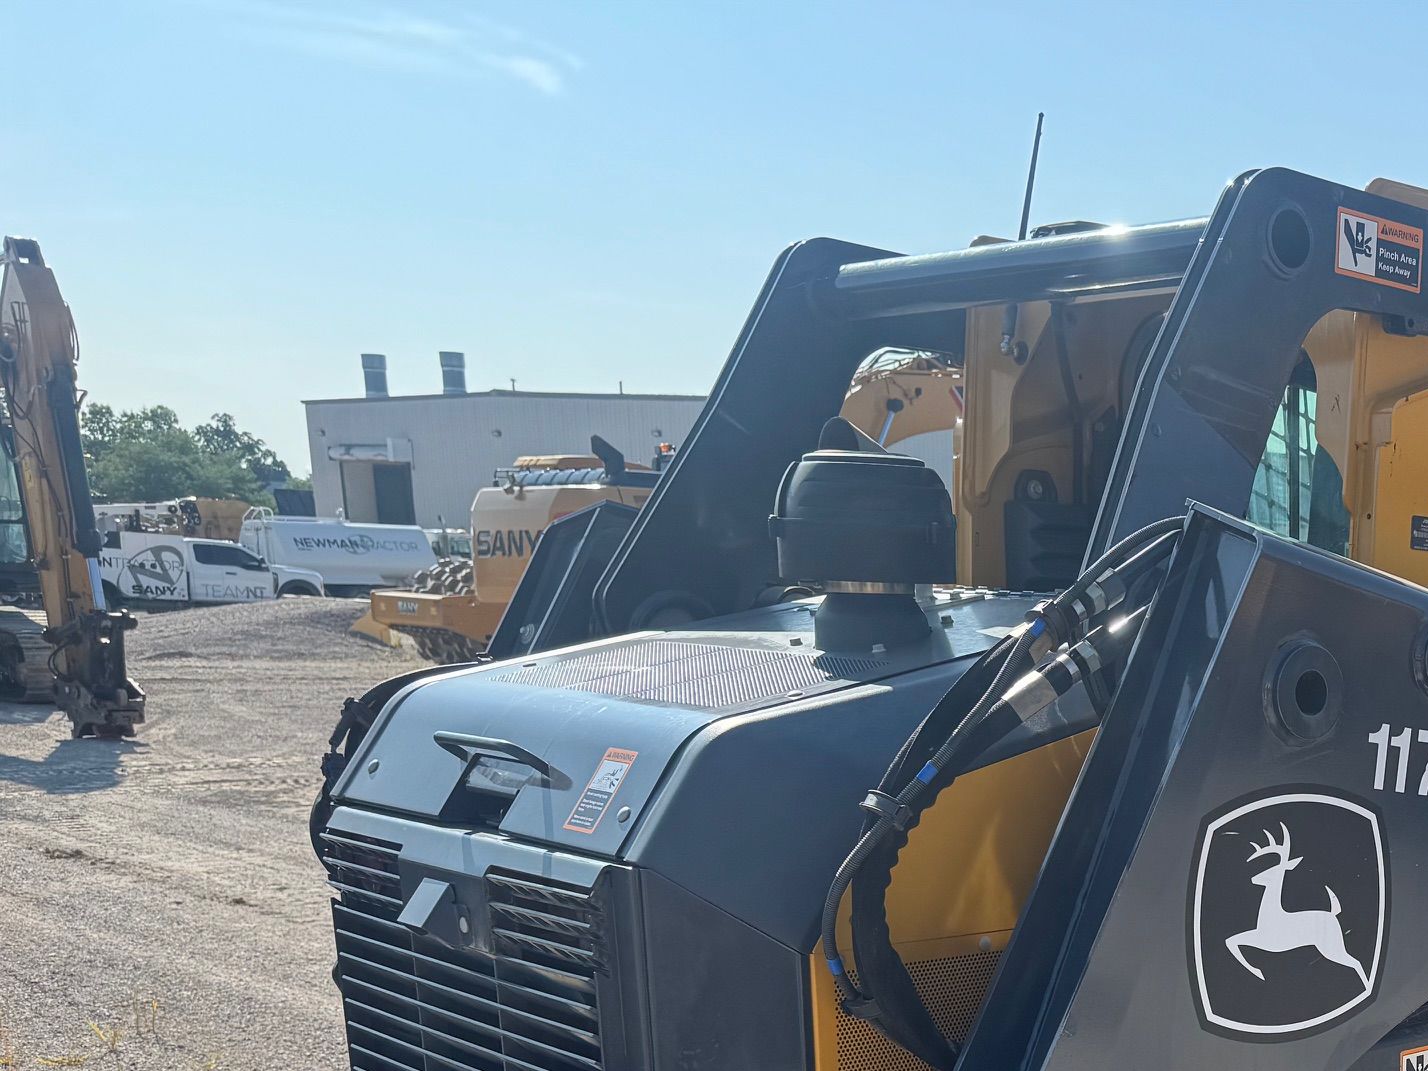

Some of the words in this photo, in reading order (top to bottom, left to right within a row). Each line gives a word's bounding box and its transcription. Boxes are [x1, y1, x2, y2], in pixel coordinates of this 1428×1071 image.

[1387, 228, 1419, 243] WARNING
[1379, 247, 1399, 261] Pinch
[1400, 253, 1417, 266] Area
[1378, 261, 1394, 274] Keep
[1395, 266, 1411, 279] Away
[477, 529, 544, 558] SANY
[132, 584, 178, 596] SANY
